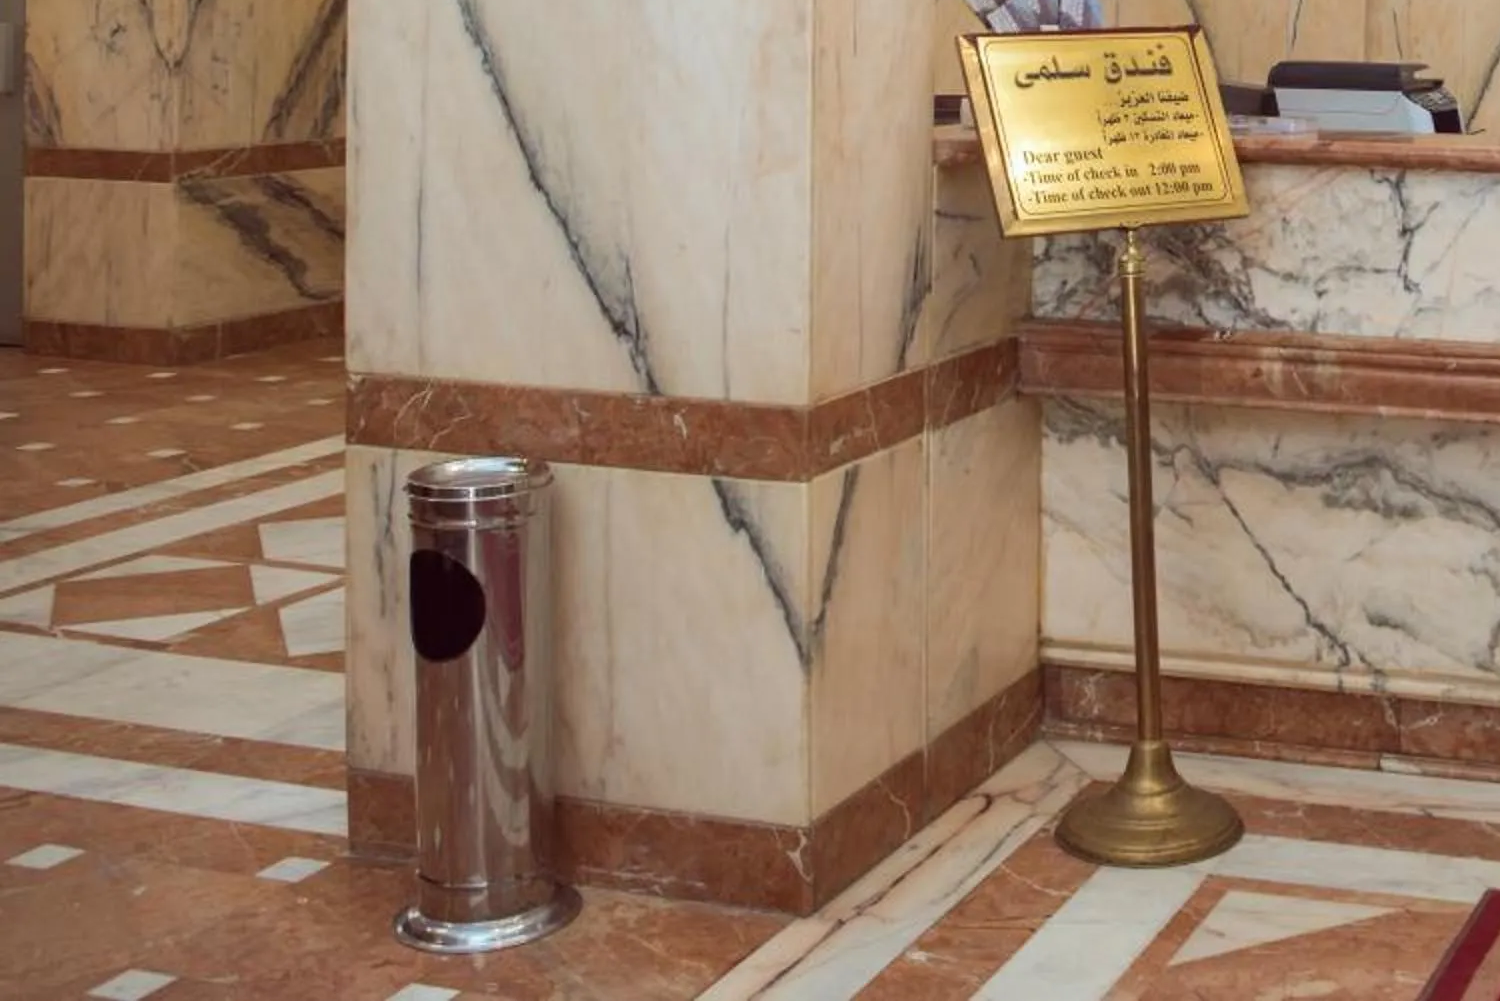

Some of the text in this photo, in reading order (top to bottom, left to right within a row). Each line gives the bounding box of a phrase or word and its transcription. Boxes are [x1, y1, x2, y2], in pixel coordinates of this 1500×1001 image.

[1014, 43, 1173, 89] فندق سلمى
[1023, 147, 1104, 164] Dear guest
[1067, 169, 1081, 182] of
[1083, 166, 1122, 180] check
[1124, 164, 1139, 177] in
[1148, 162, 1178, 176] 2:00
[1179, 163, 1202, 177] pm
[1071, 186, 1086, 201] of
[1088, 183, 1127, 201] check
[1128, 183, 1152, 198] out
[1154, 180, 1190, 196] 12:00
[1192, 181, 1214, 197] pm
